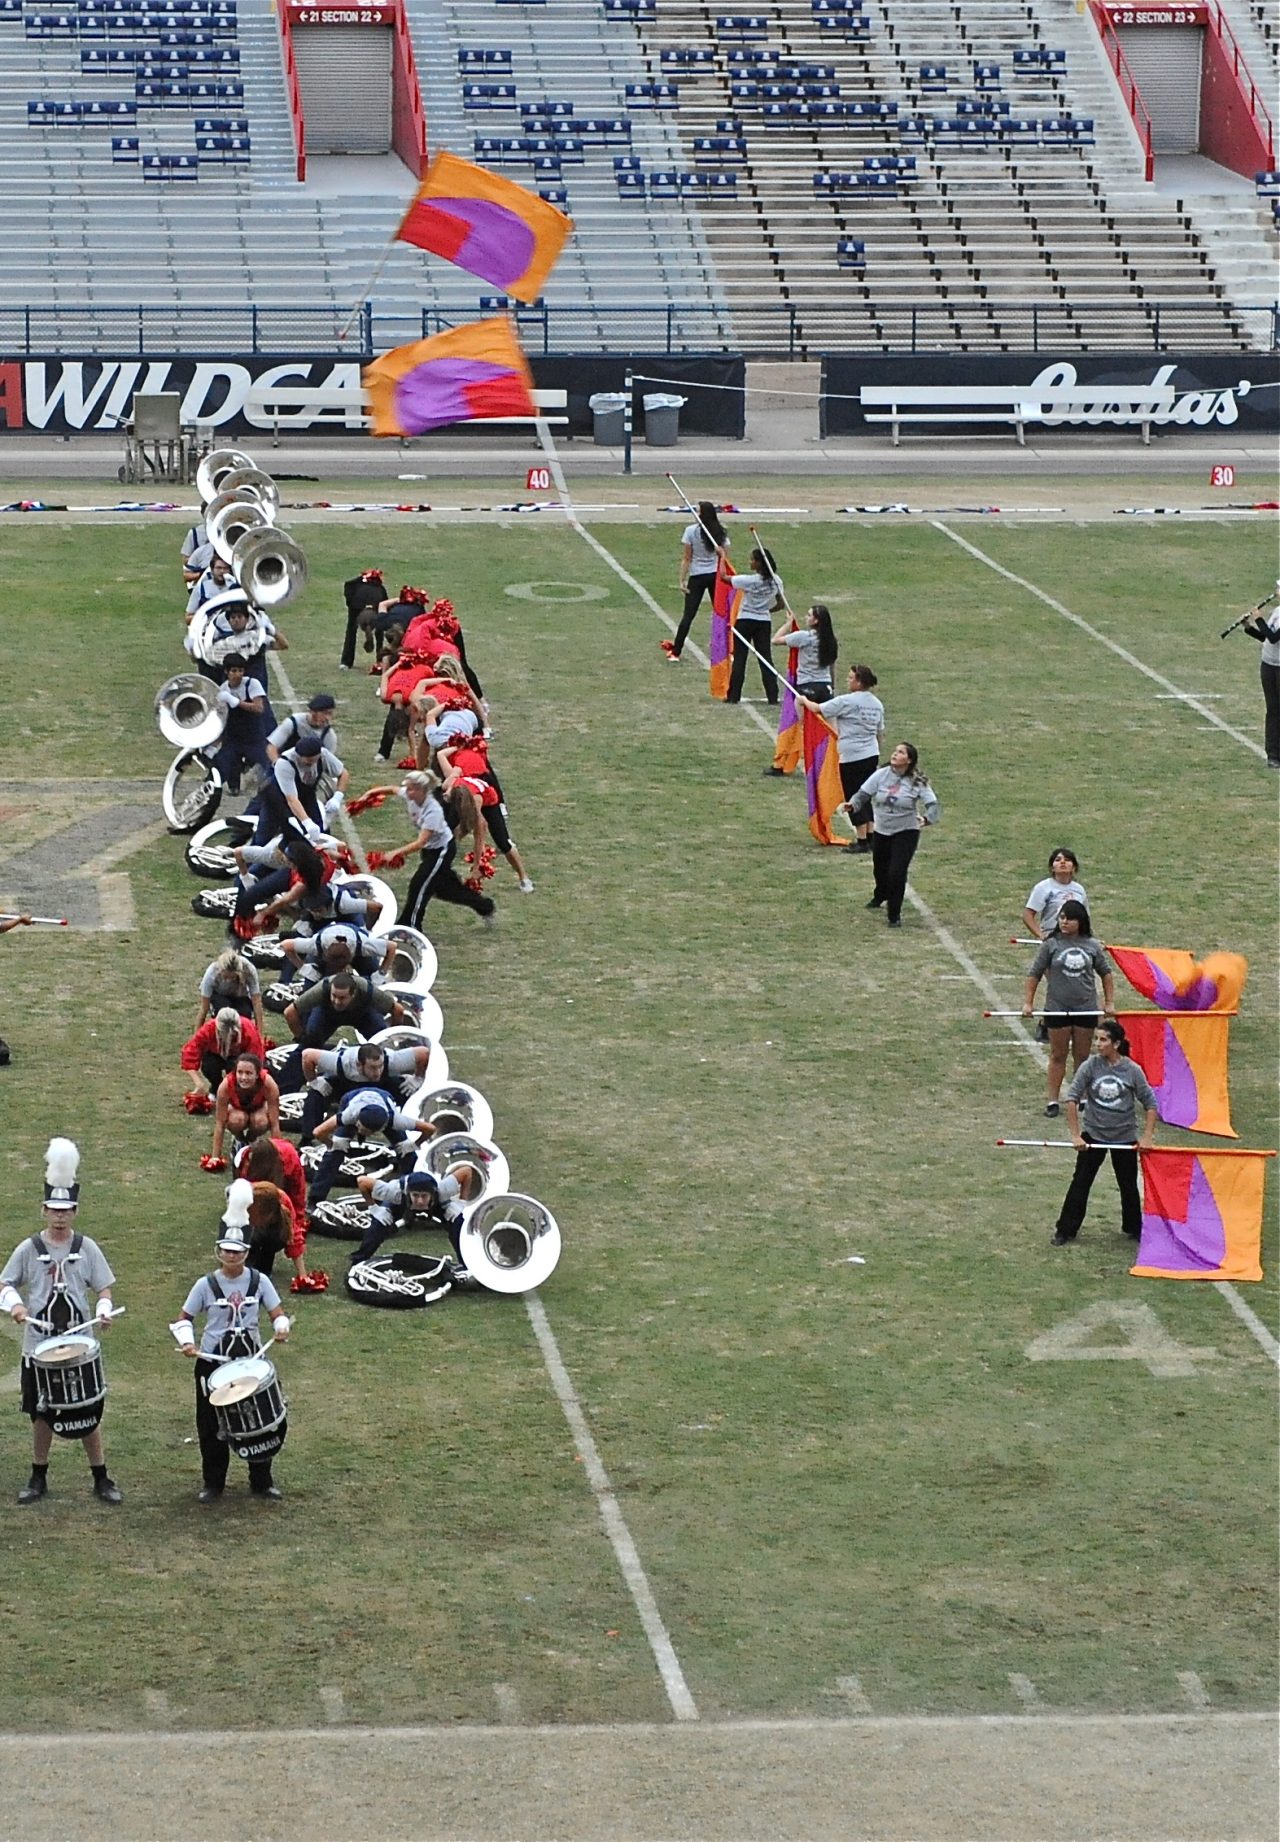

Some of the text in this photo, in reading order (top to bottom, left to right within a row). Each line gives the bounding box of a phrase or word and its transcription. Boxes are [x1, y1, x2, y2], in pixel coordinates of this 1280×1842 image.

[309, 11, 372, 22] 21 SECTION 22
[1122, 12, 1186, 24] 22 SECTION 23
[530, 469, 550, 489] 40
[1214, 466, 1234, 486] 30
[64, 1415, 98, 1432] YAMAHA
[248, 1436, 281, 1456] YAMAHA
